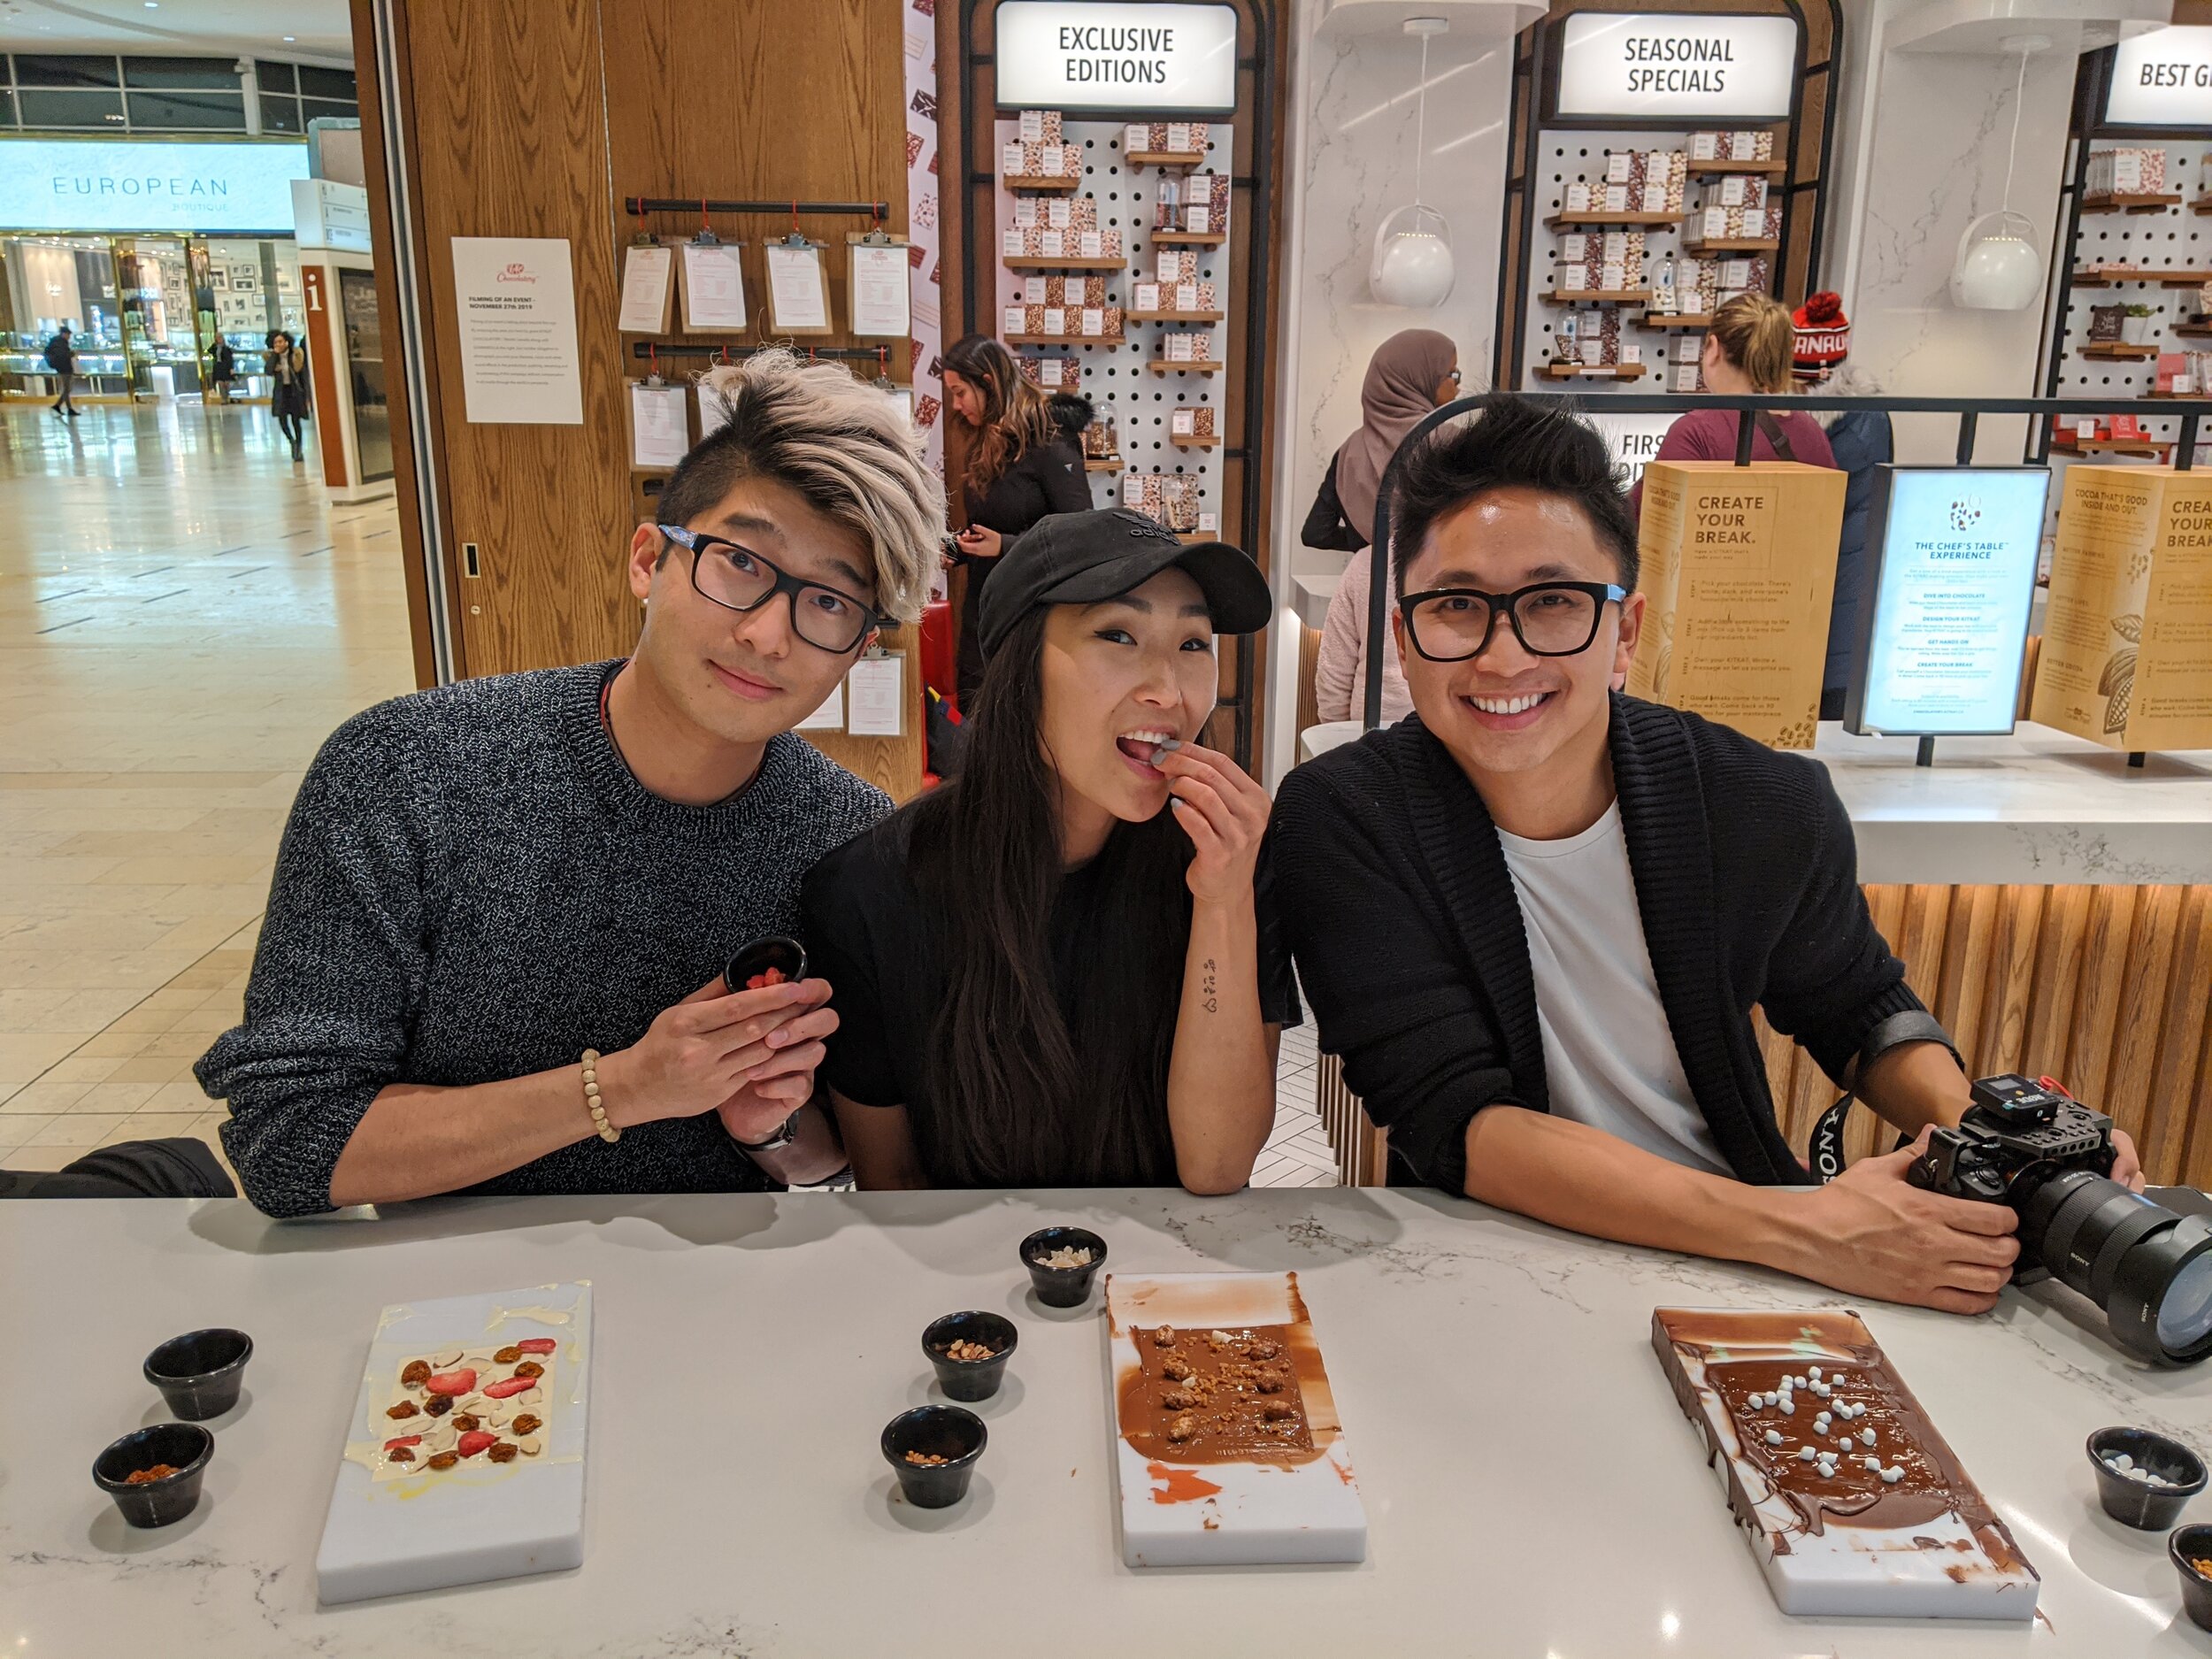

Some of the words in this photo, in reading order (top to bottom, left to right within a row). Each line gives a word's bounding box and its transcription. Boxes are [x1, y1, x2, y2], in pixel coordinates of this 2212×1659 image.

[1060, 27, 1173, 51] EXCLUSIVE
[1624, 38, 1734, 61] SEASONAL
[1066, 58, 1166, 83] EDITIONS
[1628, 69, 1725, 92] SPECIALS
[2139, 64, 2191, 87] BEST
[53, 176, 227, 196] EUROPEAN
[1623, 434, 1665, 455] FIRS
[1698, 496, 1764, 510] CREATE
[2125, 495, 2148, 505] GOOD
[1696, 514, 1746, 526] YOUR
[1694, 531, 1756, 544] BREAK.
[2070, 1252, 2090, 1266] SONY
